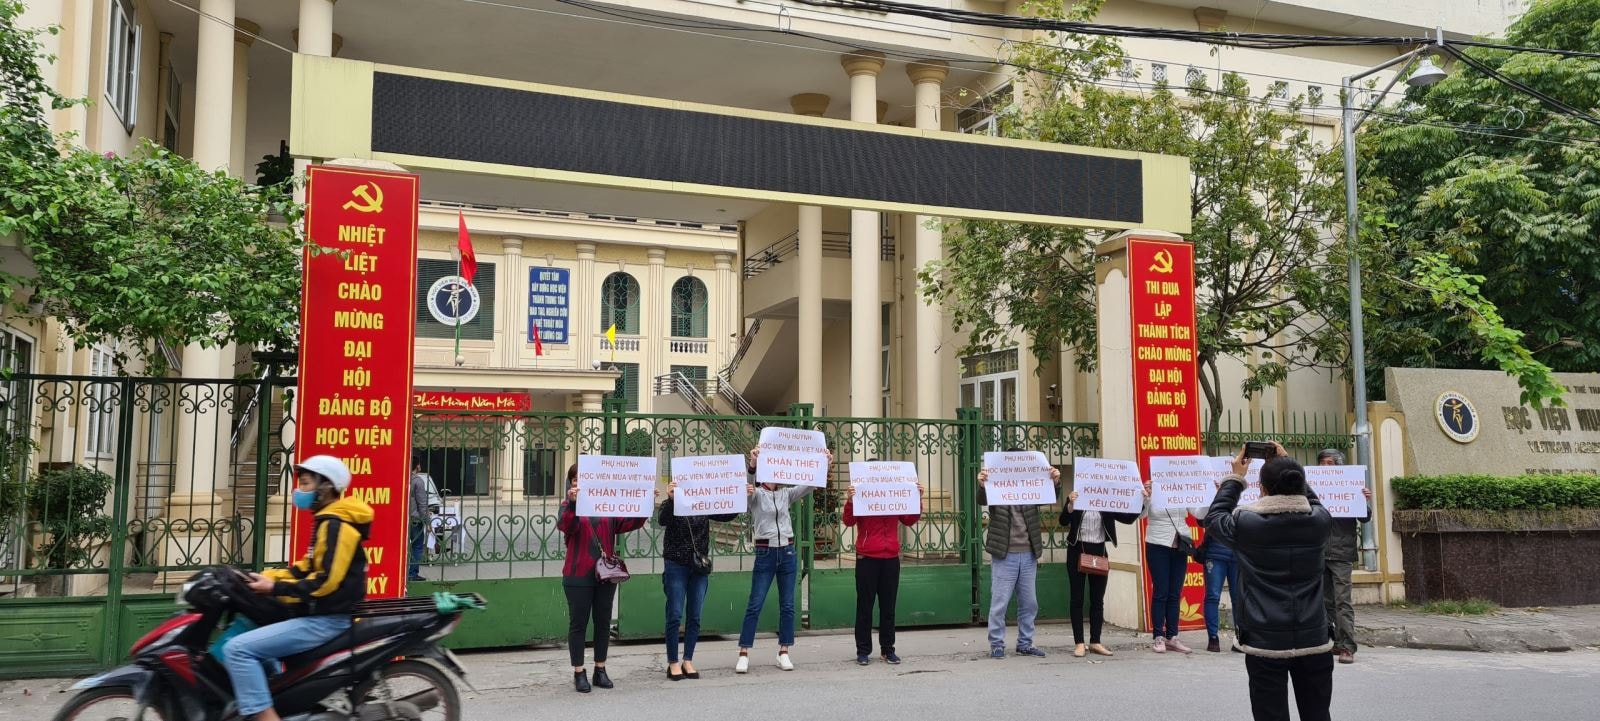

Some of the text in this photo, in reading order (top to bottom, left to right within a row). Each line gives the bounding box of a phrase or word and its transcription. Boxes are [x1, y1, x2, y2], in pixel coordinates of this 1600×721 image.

[338, 224, 386, 247] NHIỆT
[344, 252, 378, 275] LIỆT
[338, 280, 382, 301] CHÀO
[1146, 280, 1180, 296] THI ĐUA
[334, 309, 384, 330] MỪNG
[1155, 301, 1172, 319] LẬP
[1138, 323, 1190, 340] THÀNH TÍCH
[344, 341, 372, 361] ĐẠI
[1138, 345, 1191, 362] CHÀO MỪNG
[343, 367, 371, 390] HỘI
[1149, 367, 1182, 386] ĐẠI HỘI
[319, 393, 392, 420] ĐẢNG BỘ
[1147, 386, 1187, 409] ĐẢNG BỘ
[1157, 410, 1178, 428] KHỐI
[1501, 406, 1532, 435] HỌC
[315, 425, 392, 449] HỌC VIỆN
[1141, 432, 1197, 451] CÁC TRƯỜNG
[352, 487, 391, 505] NAM
[367, 573, 388, 595] KỲ
